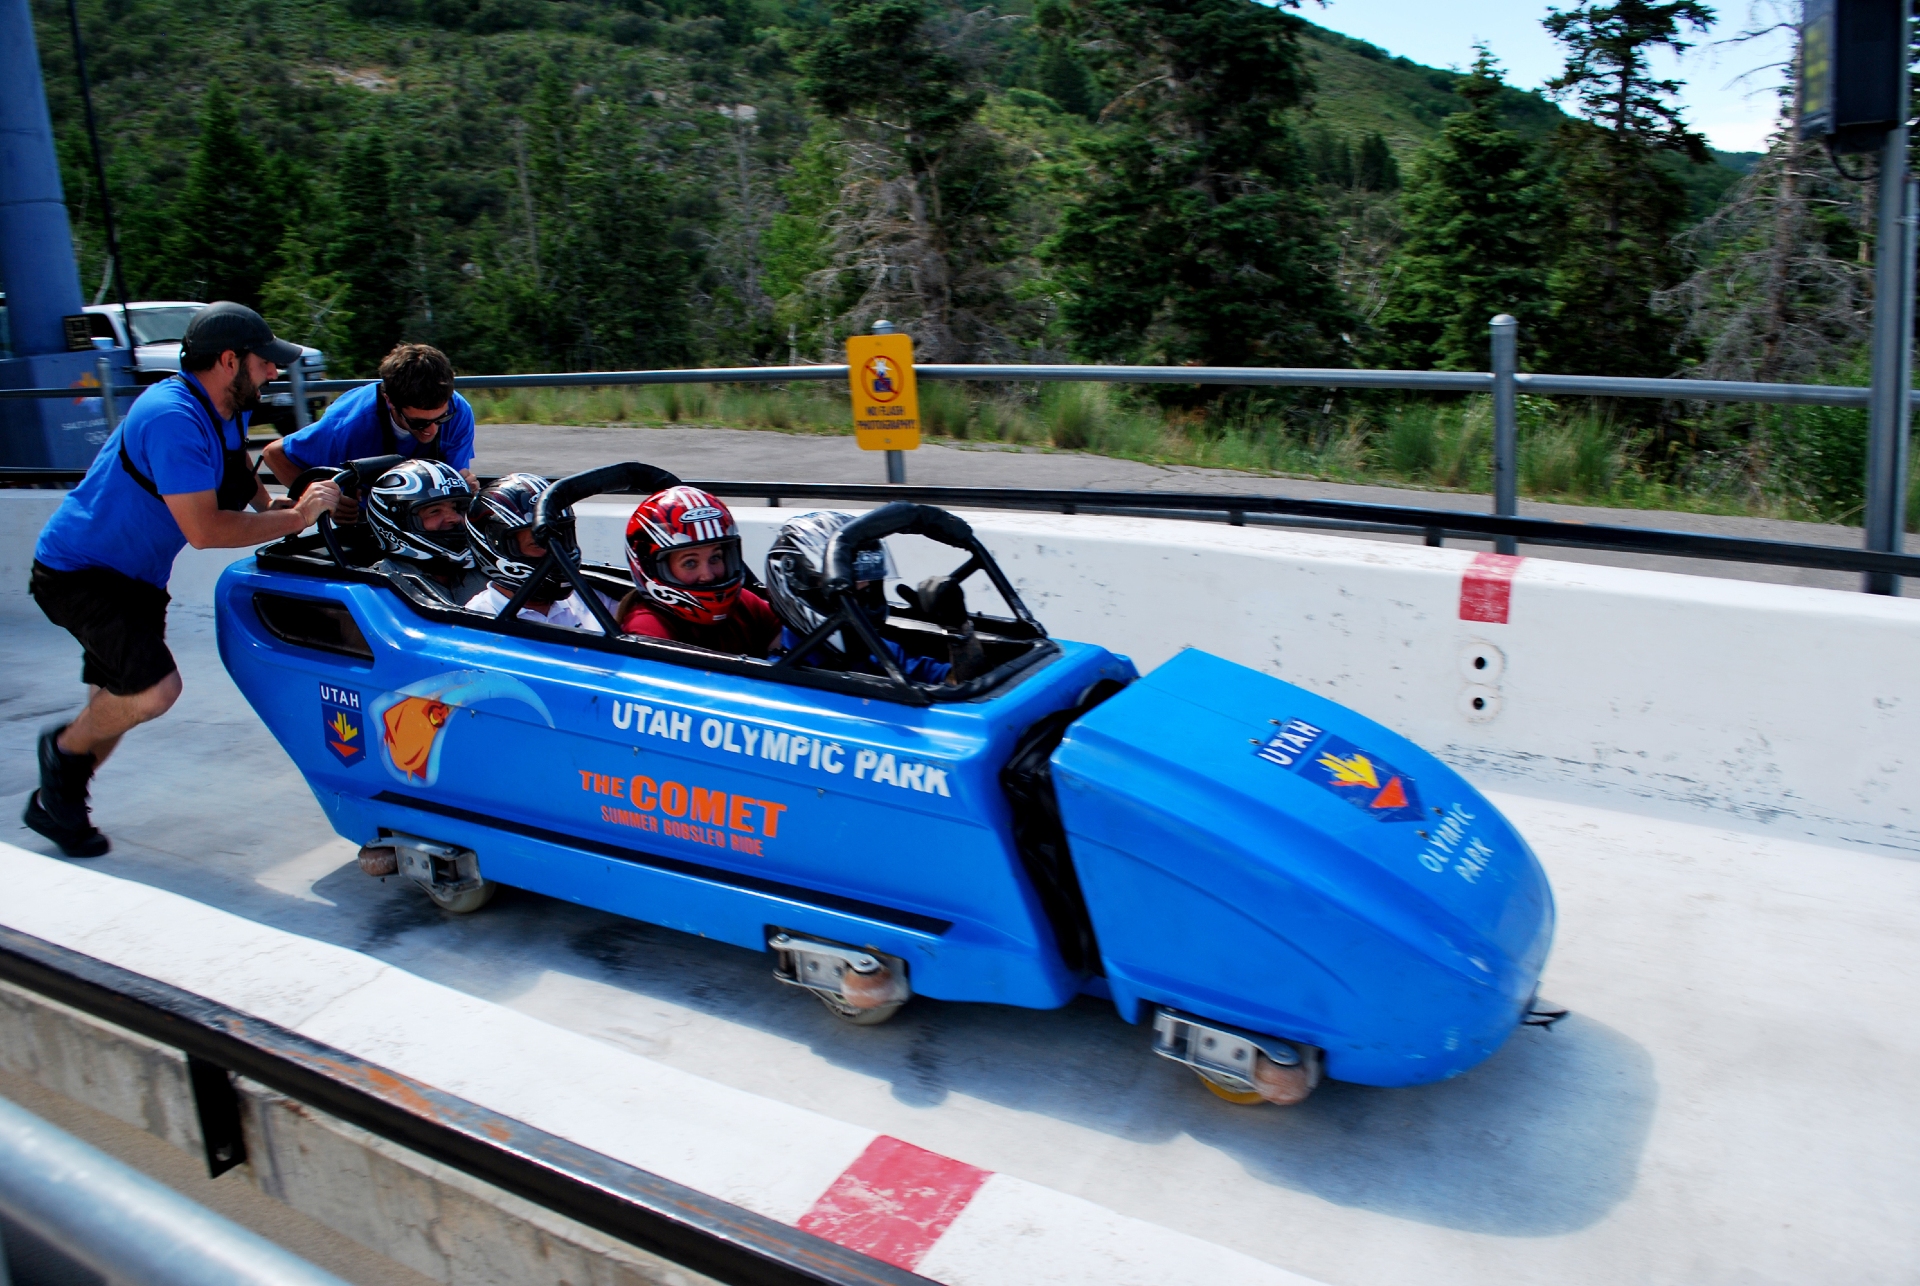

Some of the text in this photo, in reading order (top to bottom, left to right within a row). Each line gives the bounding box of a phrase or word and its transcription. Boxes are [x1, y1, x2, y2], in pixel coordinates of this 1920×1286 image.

[320, 684, 360, 708] UTAH
[612, 699, 952, 798] UTAH OLYMPIC PARK
[1257, 720, 1323, 766] UTAH
[578, 769, 787, 838] THE COMET
[601, 805, 765, 857] SUMMER BOBSLED RIDE
[1417, 802, 1477, 873] OLYMPIC
[1454, 836, 1495, 885] PARK
